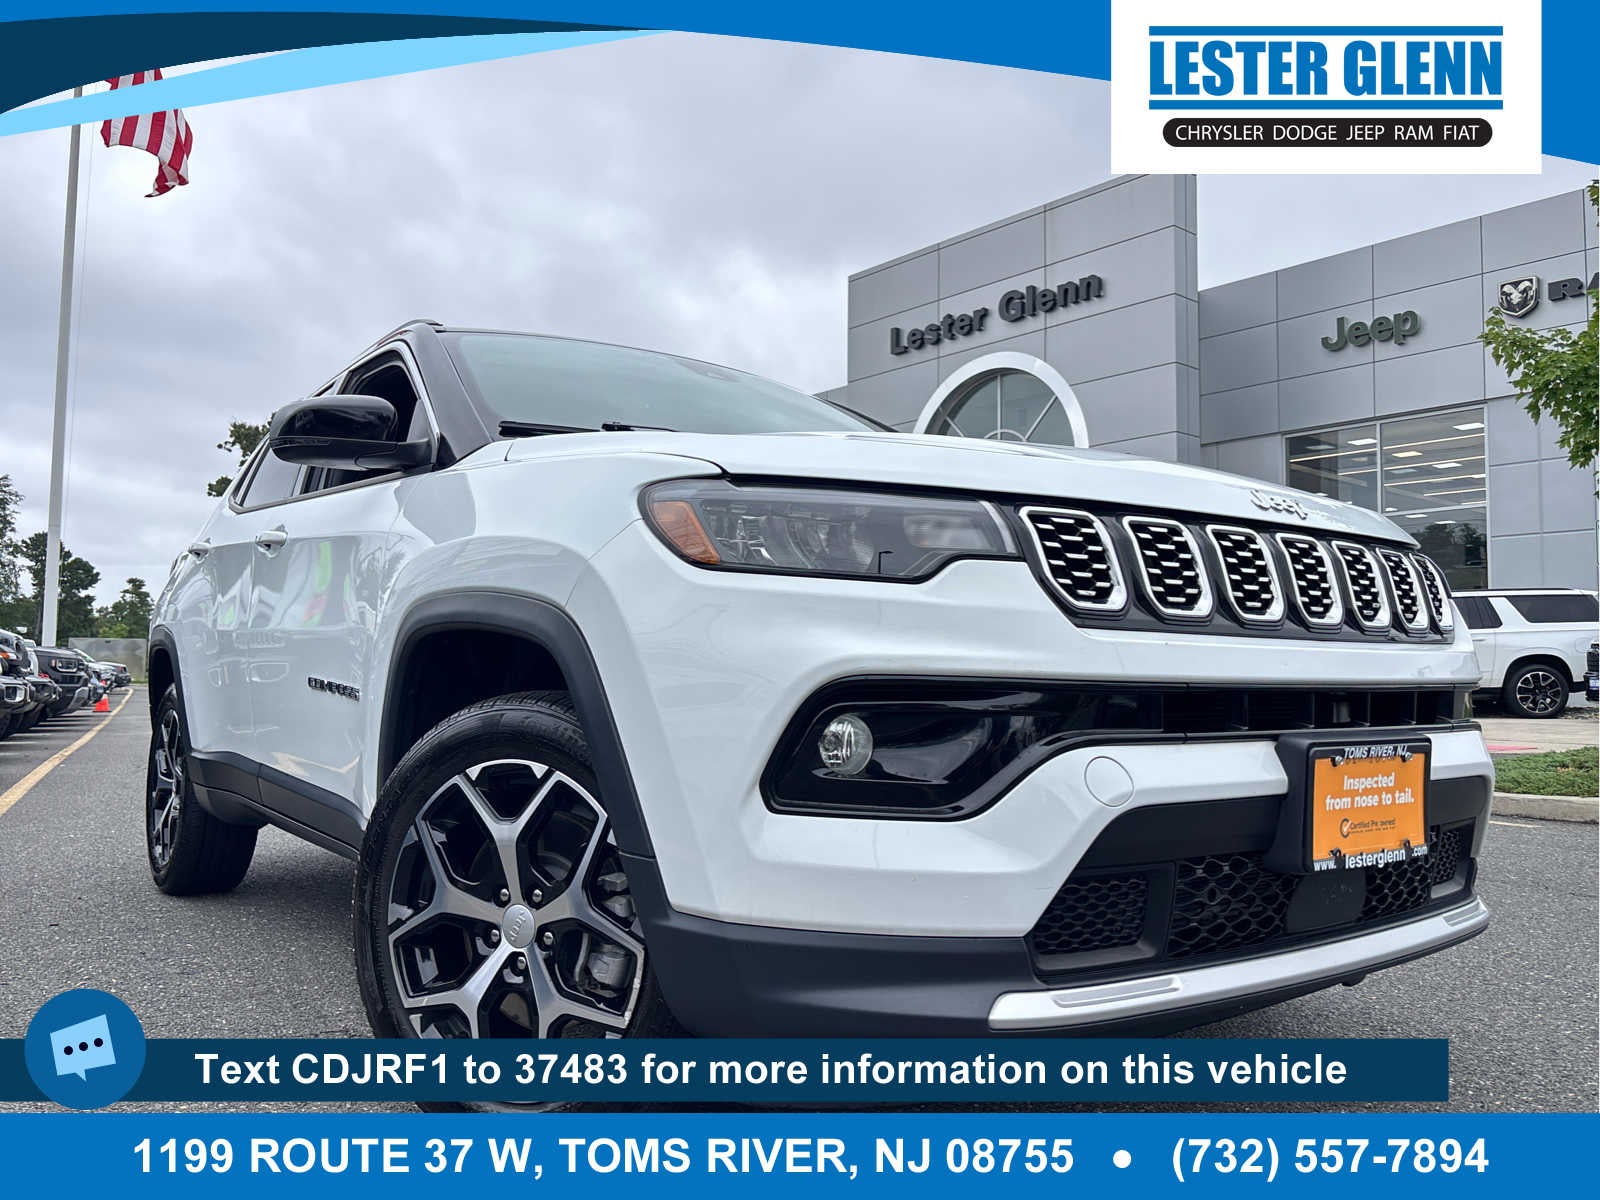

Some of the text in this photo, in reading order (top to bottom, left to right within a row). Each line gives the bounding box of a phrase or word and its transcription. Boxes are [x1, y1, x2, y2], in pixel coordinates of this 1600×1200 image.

[890, 274, 1105, 356] Lester Glenn
[1321, 310, 1421, 352] Jeep
[1343, 746, 1369, 759] TOMS
[1369, 745, 1396, 758] RIVER,
[1343, 771, 1395, 793] Inspected
[1325, 787, 1415, 812] from nose to tail.
[1313, 845, 1428, 872] www. lesterglenn .com
